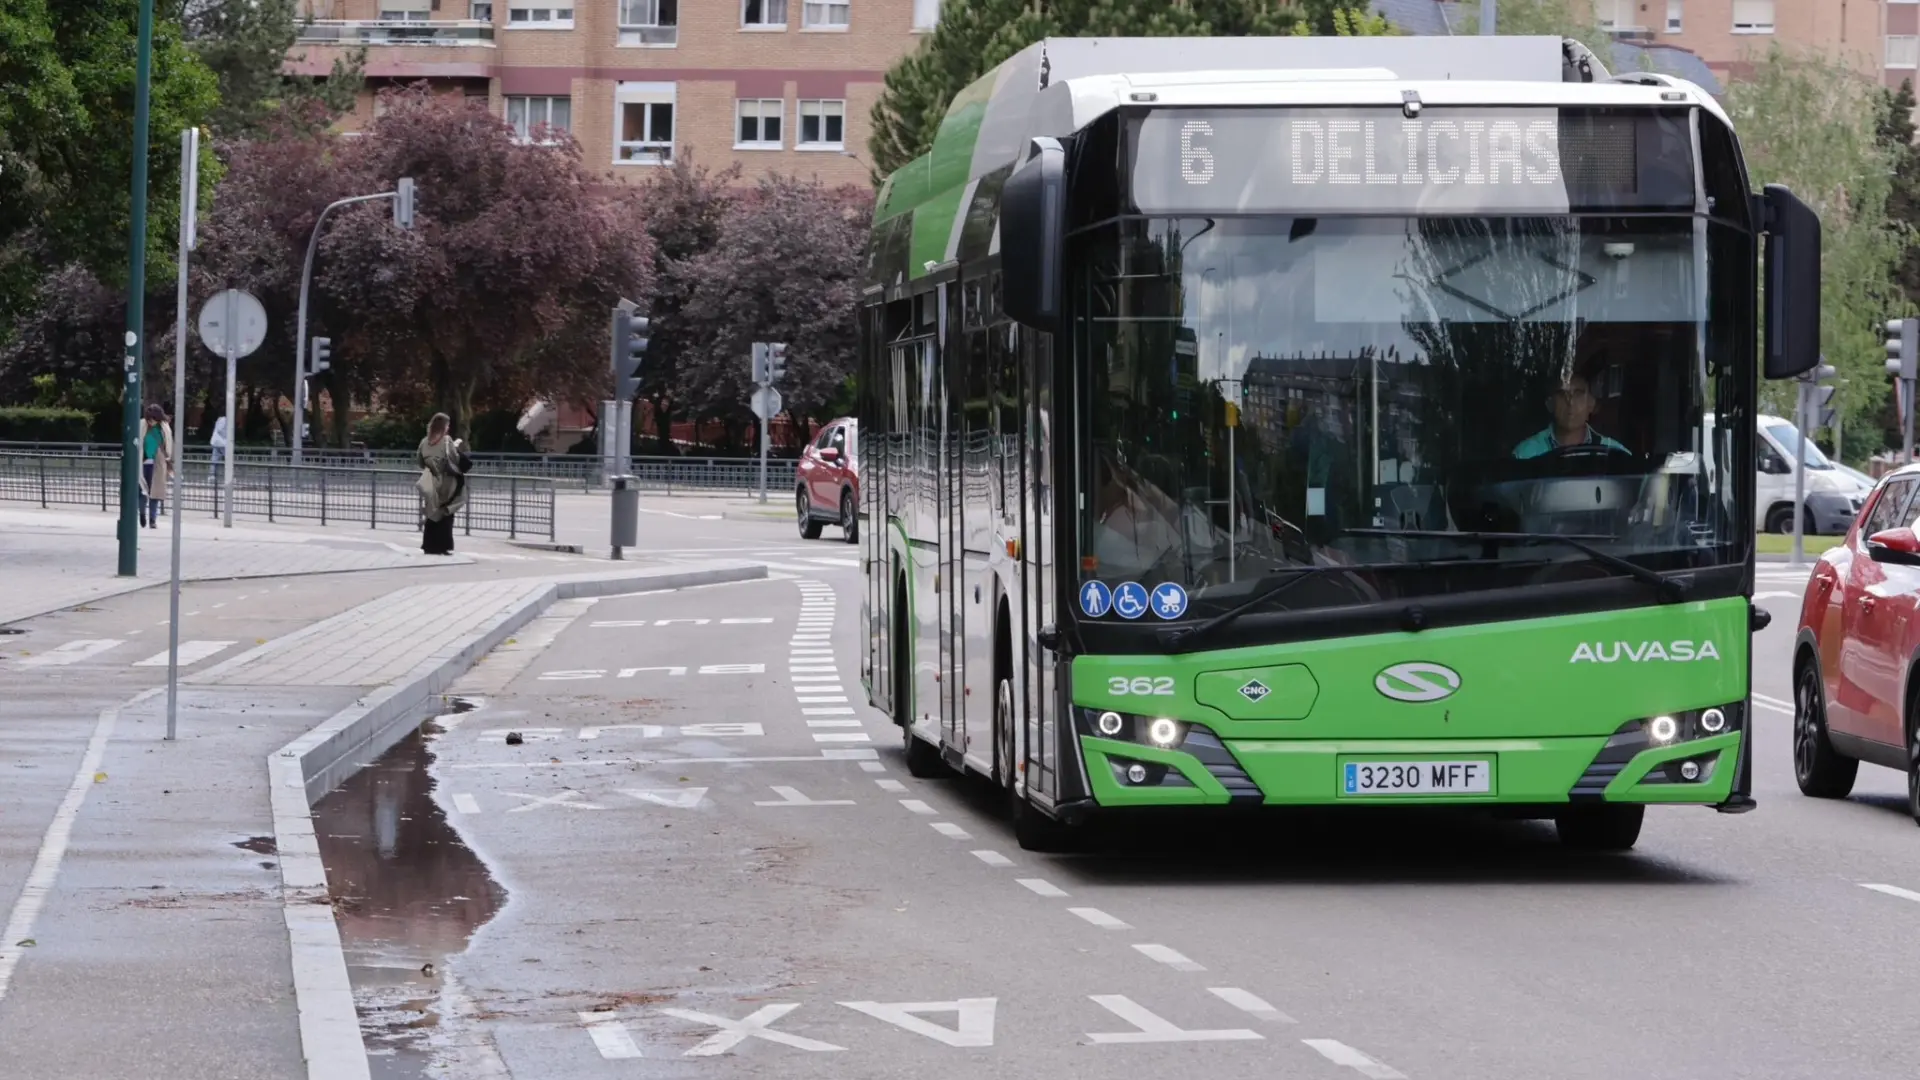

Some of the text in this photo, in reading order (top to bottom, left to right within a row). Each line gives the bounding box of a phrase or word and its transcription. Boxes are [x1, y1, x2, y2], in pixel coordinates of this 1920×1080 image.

[1180, 120, 1559, 185] 6 DELICIAS
[1569, 640, 1719, 664] AUVASA
[536, 663, 766, 681] BUS
[1107, 676, 1175, 696] 362
[1243, 686, 1266, 696] CNG
[477, 722, 765, 742] BUS
[1360, 764, 1478, 789] 3230 MFF
[452, 786, 856, 814] TAXI
[577, 995, 1264, 1058] TAXI
